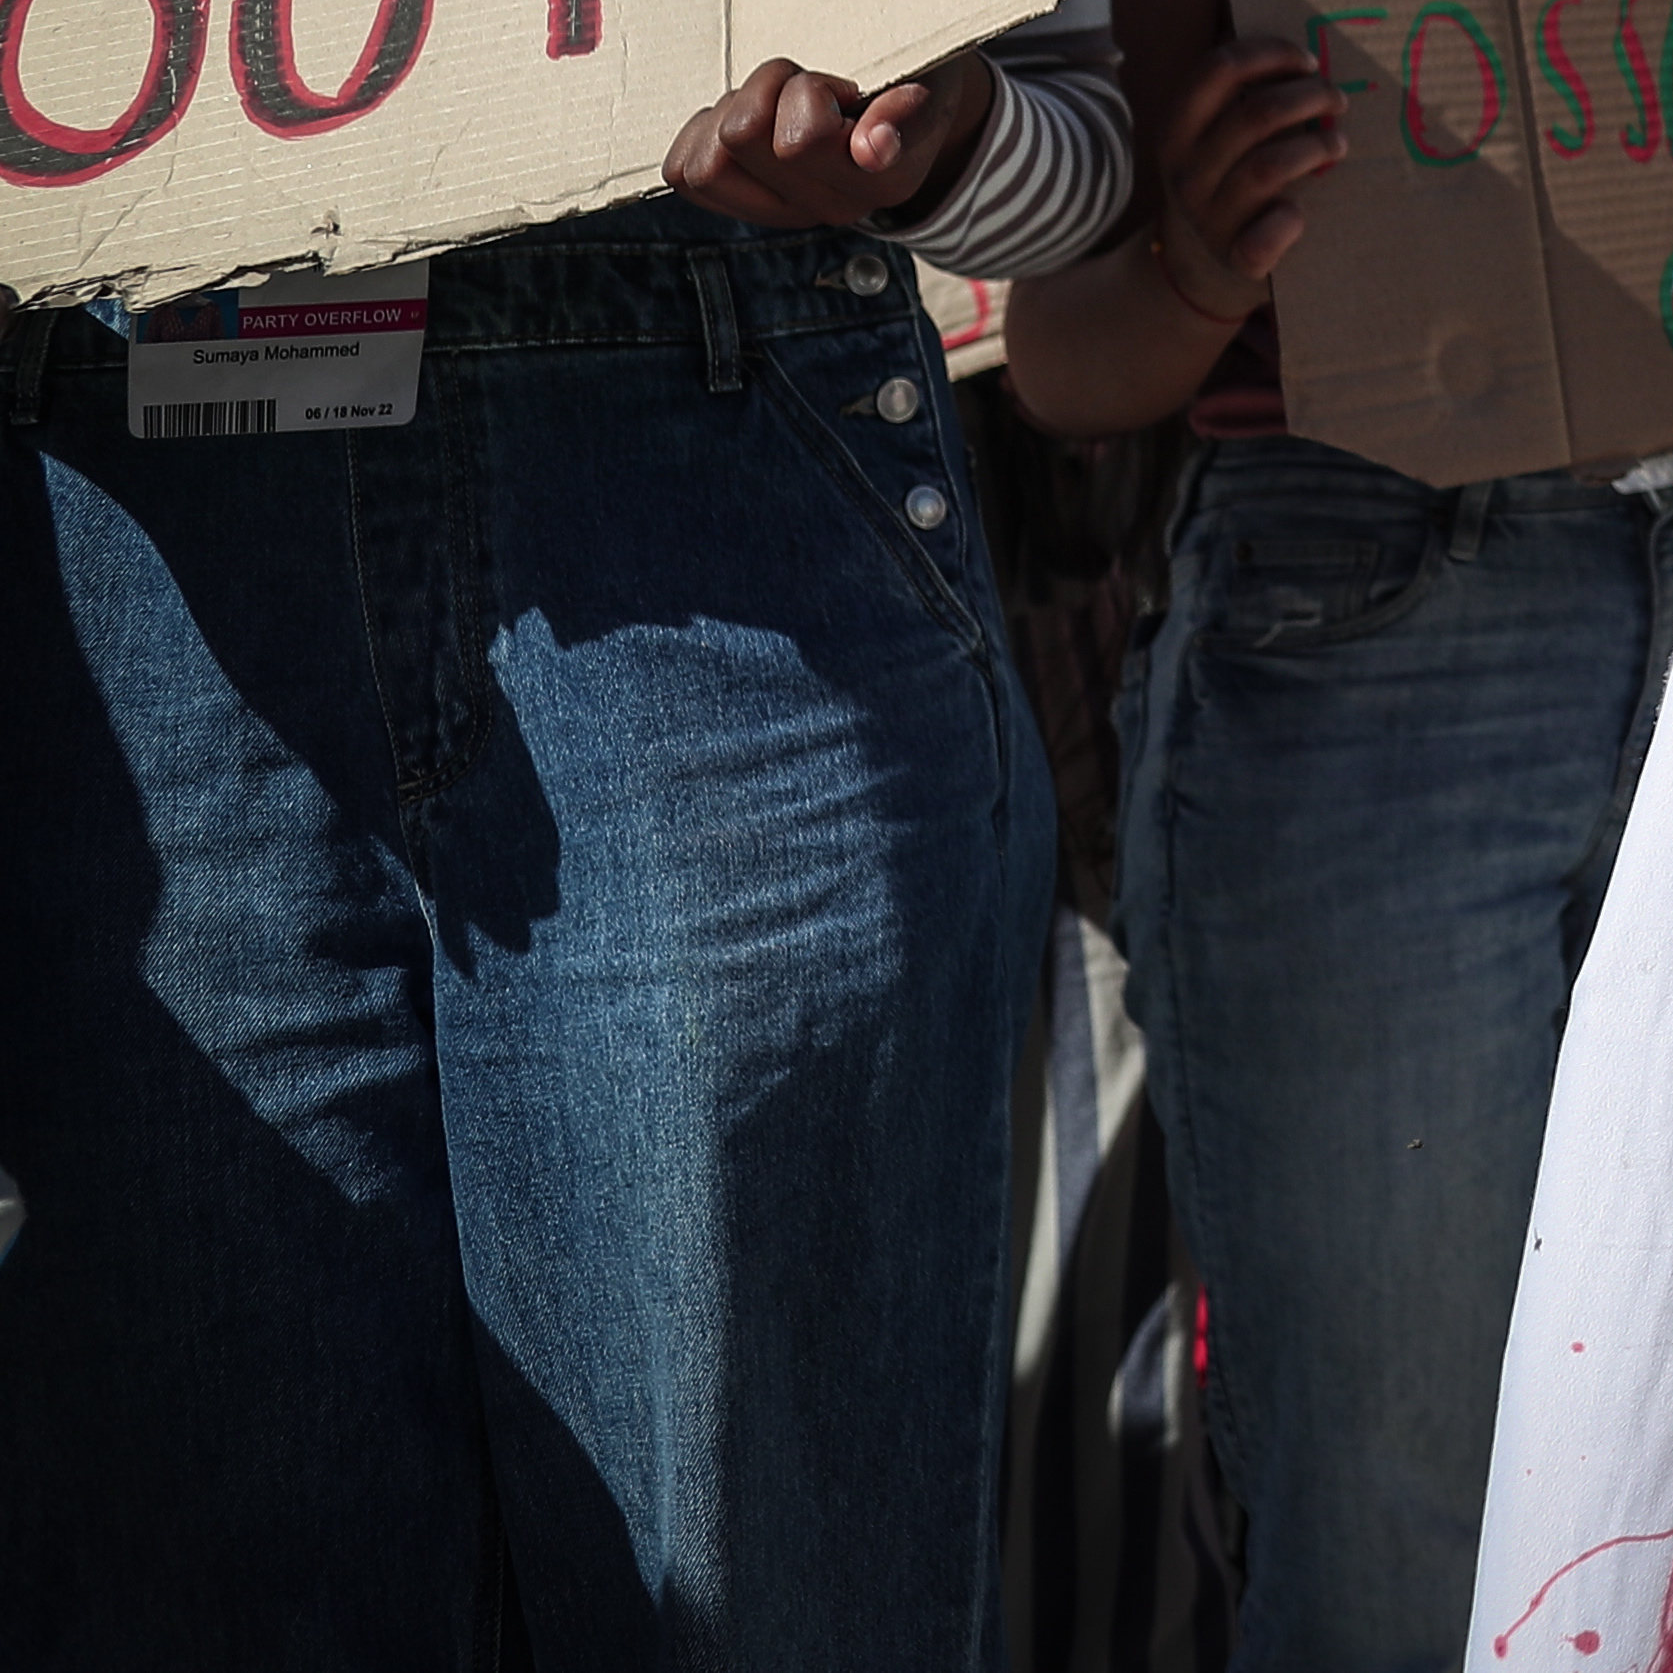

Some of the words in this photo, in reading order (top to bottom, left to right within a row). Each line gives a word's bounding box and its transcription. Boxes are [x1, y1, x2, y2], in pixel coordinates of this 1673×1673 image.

[242, 312, 299, 331] PARTY
[304, 308, 402, 327] OVERFLOW
[192, 349, 260, 367] Sumaya
[264, 342, 360, 361] Mohammed
[304, 407, 321, 420] 06
[333, 406, 347, 419] 18
[350, 404, 376, 418] Nov
[378, 403, 393, 416] 22
